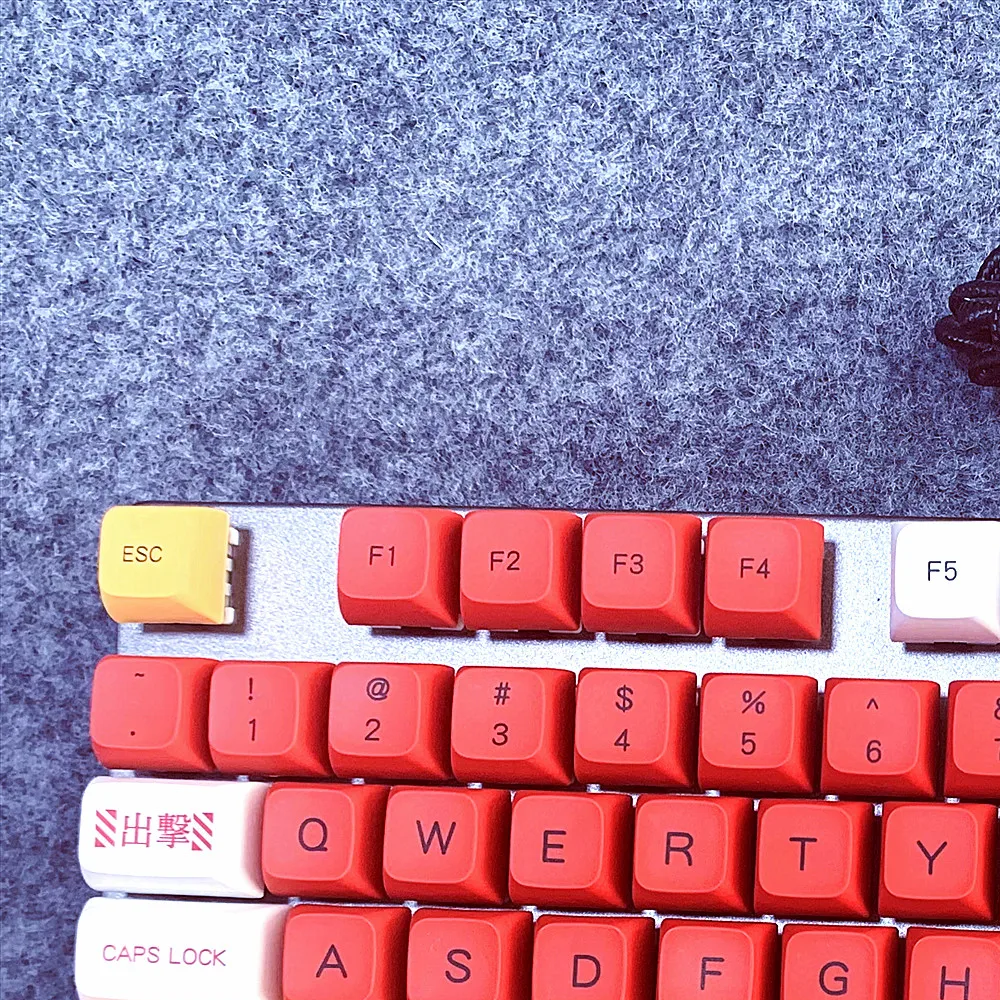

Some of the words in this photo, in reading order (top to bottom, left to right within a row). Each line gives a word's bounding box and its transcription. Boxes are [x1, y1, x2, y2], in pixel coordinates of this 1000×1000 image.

[122, 545, 163, 563] ESC
[369, 545, 395, 567] F1
[490, 550, 520, 572] F2
[613, 553, 644, 575] F3
[740, 557, 771, 579] F4
[927, 560, 958, 582] F5
[248, 718, 256, 742] 1
[364, 718, 381, 742] 2
[491, 722, 509, 747] 3
[613, 728, 631, 752] 4
[741, 731, 757, 756] 5
[866, 739, 882, 764] 6
[298, 817, 328, 852] Q
[415, 819, 457, 856] W
[541, 829, 567, 864] E
[664, 831, 694, 867] R
[788, 836, 818, 871] T
[916, 840, 948, 876] Y
[102, 944, 160, 964] CAPS
[169, 947, 226, 967] LOCK
[315, 943, 348, 979] A
[445, 948, 472, 984] S
[571, 954, 602, 989] D
[699, 956, 725, 991] F
[818, 960, 849, 997] G
